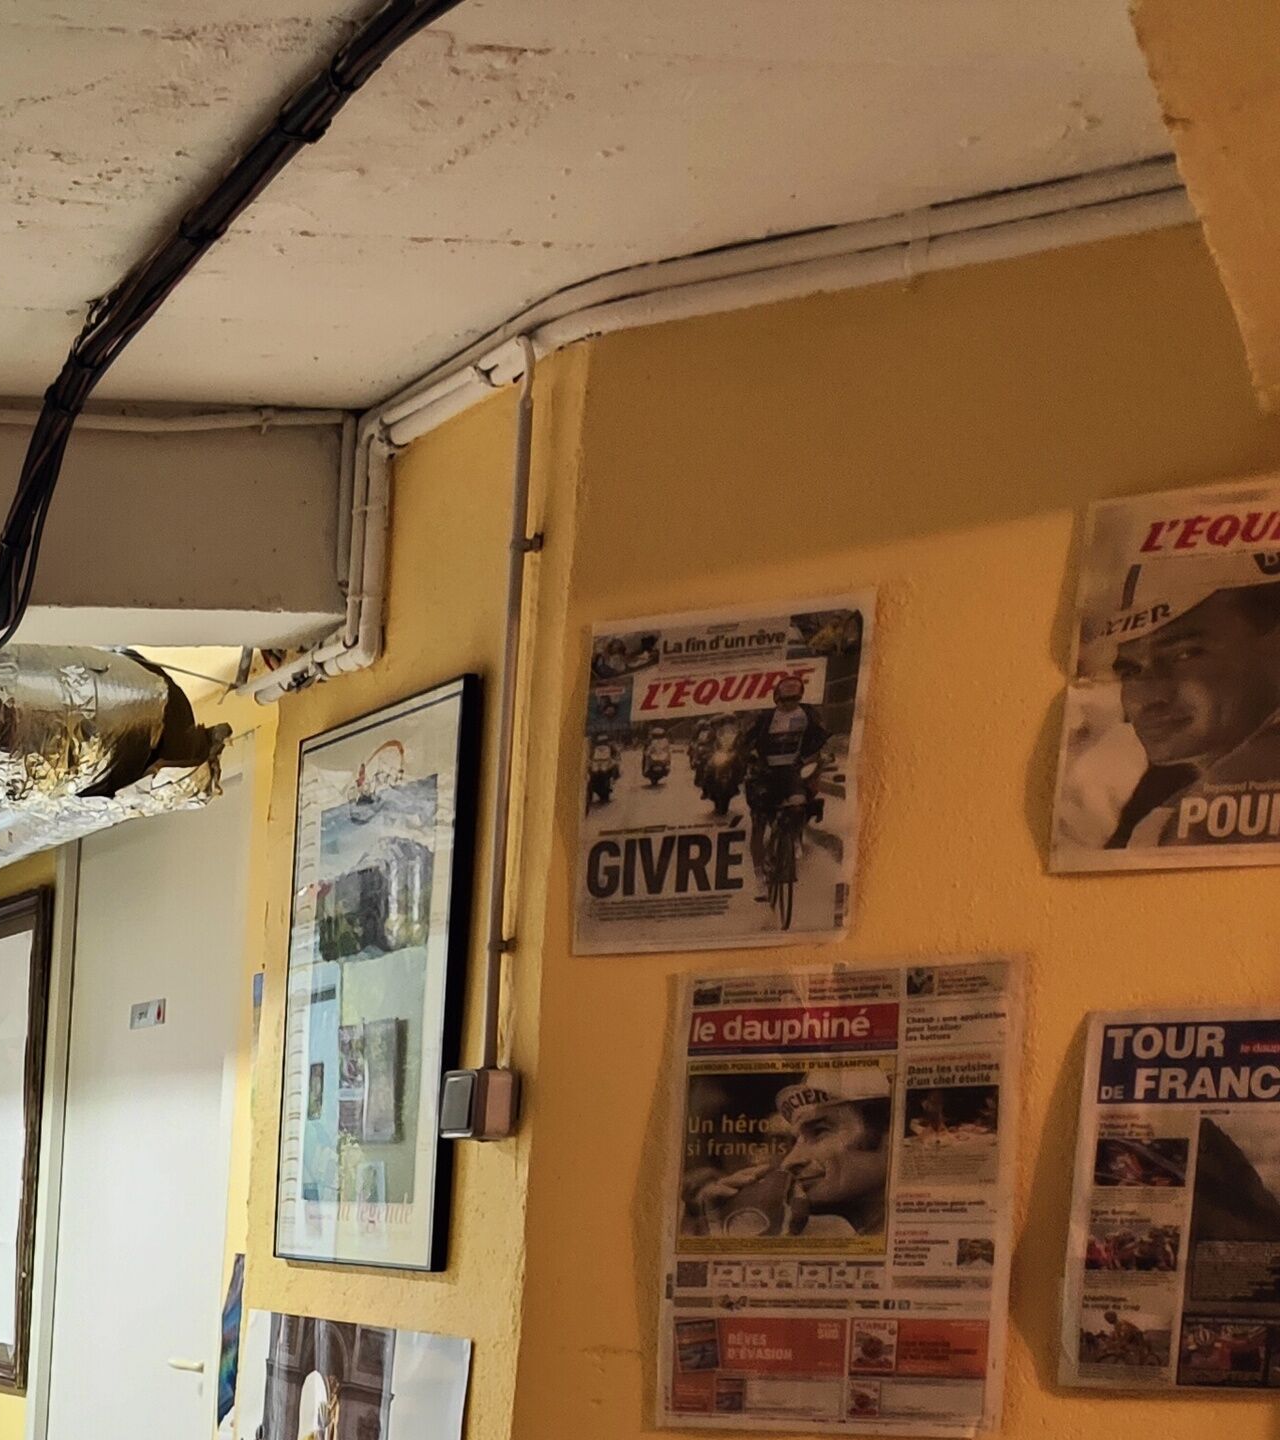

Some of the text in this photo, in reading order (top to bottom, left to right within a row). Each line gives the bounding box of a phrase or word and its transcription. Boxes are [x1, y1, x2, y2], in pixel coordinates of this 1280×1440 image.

[663, 628, 786, 656] La fin d'un rêve
[587, 815, 747, 899] GIVRÉ
[692, 1006, 871, 1046] le dauphiné
[1107, 1025, 1226, 1060] TOUR
[831, 1058, 880, 1069] CHAMPION
[933, 1074, 956, 1085] chef
[1100, 1085, 1125, 1100] DE
[688, 1112, 778, 1134] Un héro
[687, 1137, 788, 1159] si français
